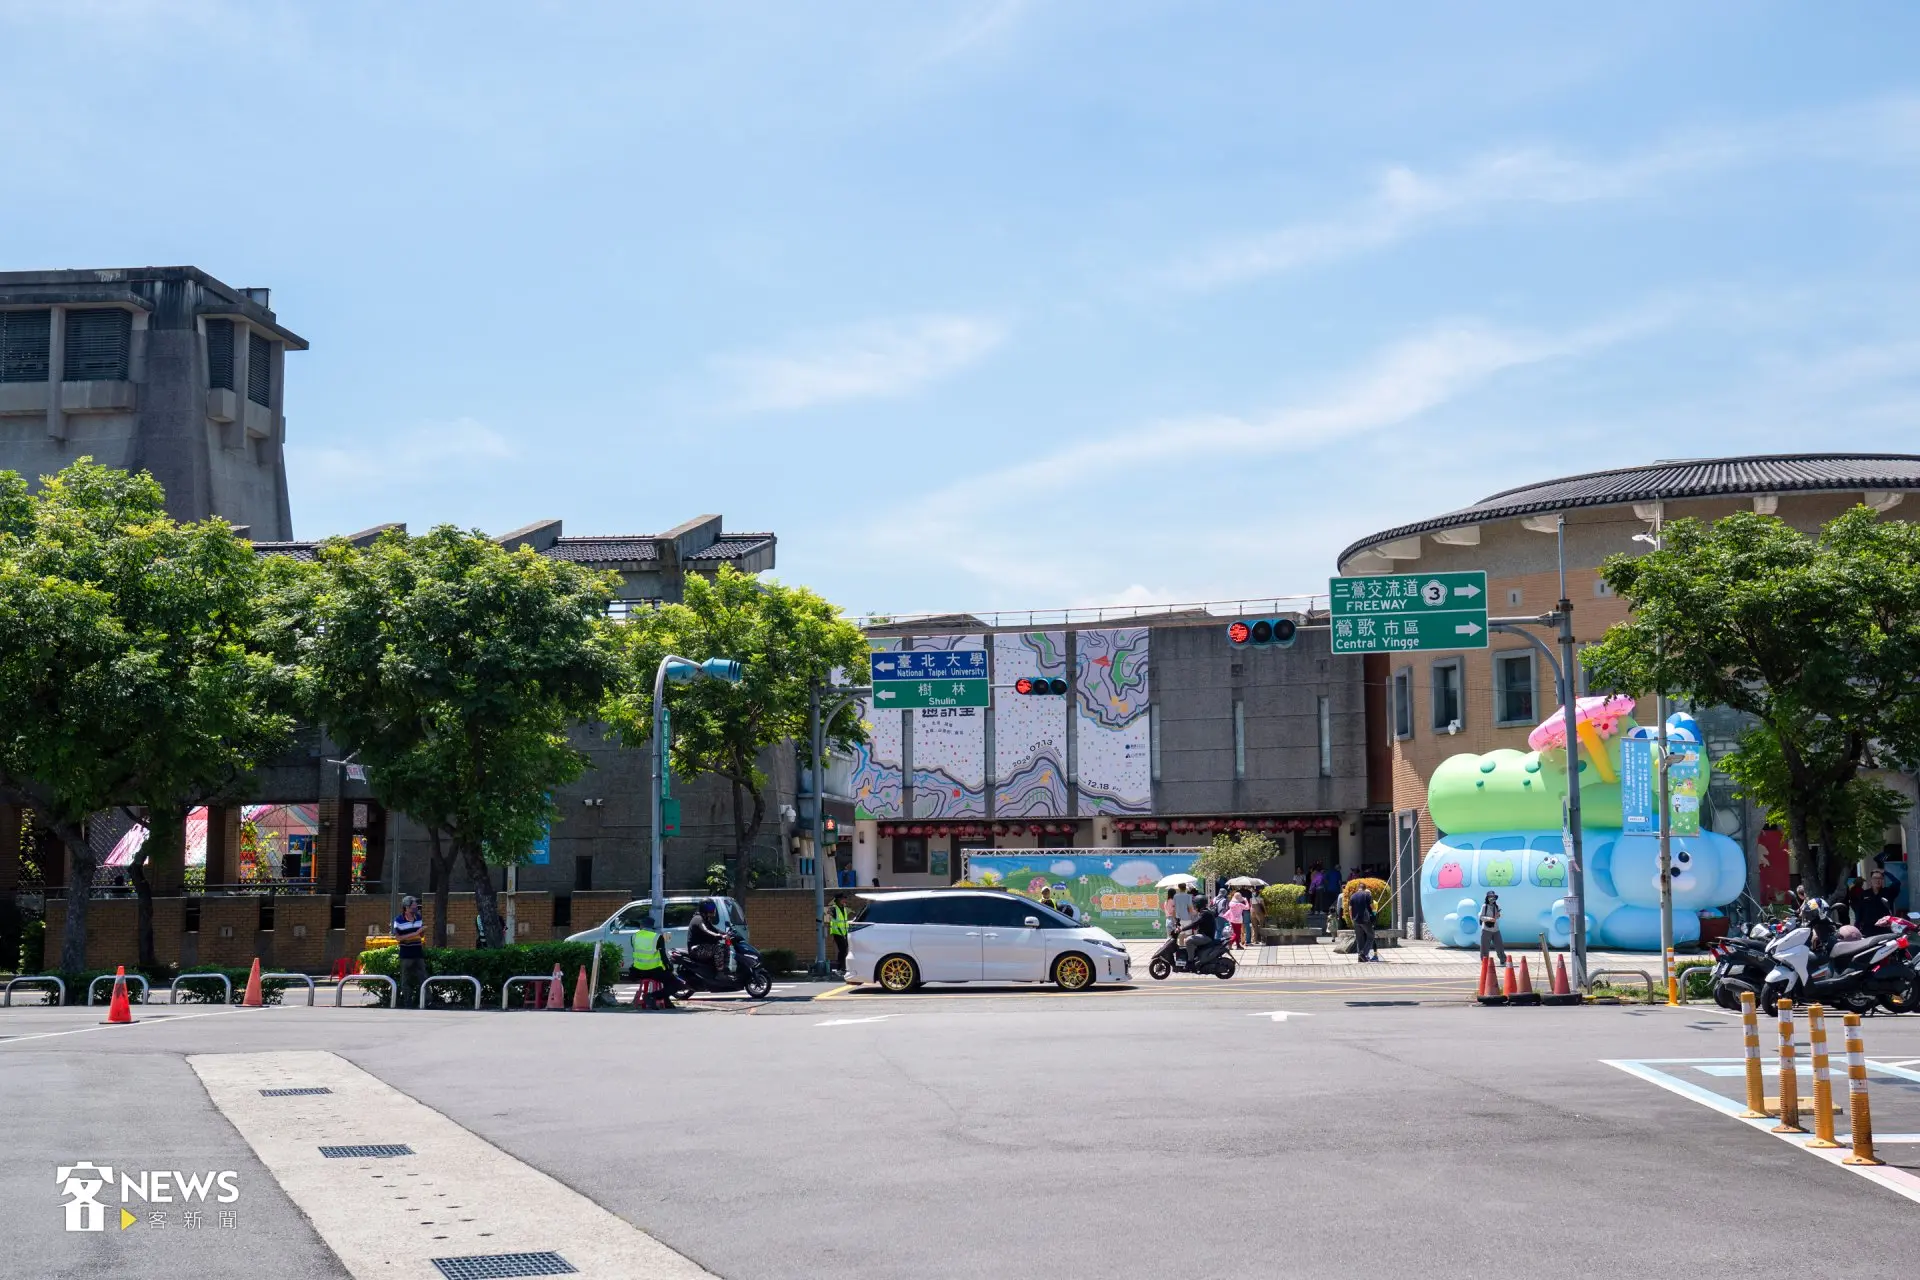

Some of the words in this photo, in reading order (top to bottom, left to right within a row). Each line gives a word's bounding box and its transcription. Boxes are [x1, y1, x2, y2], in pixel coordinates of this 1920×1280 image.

[1335, 579, 1418, 599] 三鶯交流道
[1429, 586, 1441, 601] 3
[1346, 599, 1407, 612] FREEWAY
[1335, 618, 1419, 637] 鶯歌市區
[1336, 638, 1376, 649] Central
[1382, 637, 1420, 649] Yingge
[897, 652, 984, 669] 臺北大學
[897, 669, 924, 677] National
[928, 669, 947, 677] Taipei
[951, 668, 985, 677] University
[918, 682, 966, 697] 樹林
[928, 697, 957, 706] Shulin
[1012, 755, 1031, 767] 2026
[1029, 739, 1053, 752] 07.13
